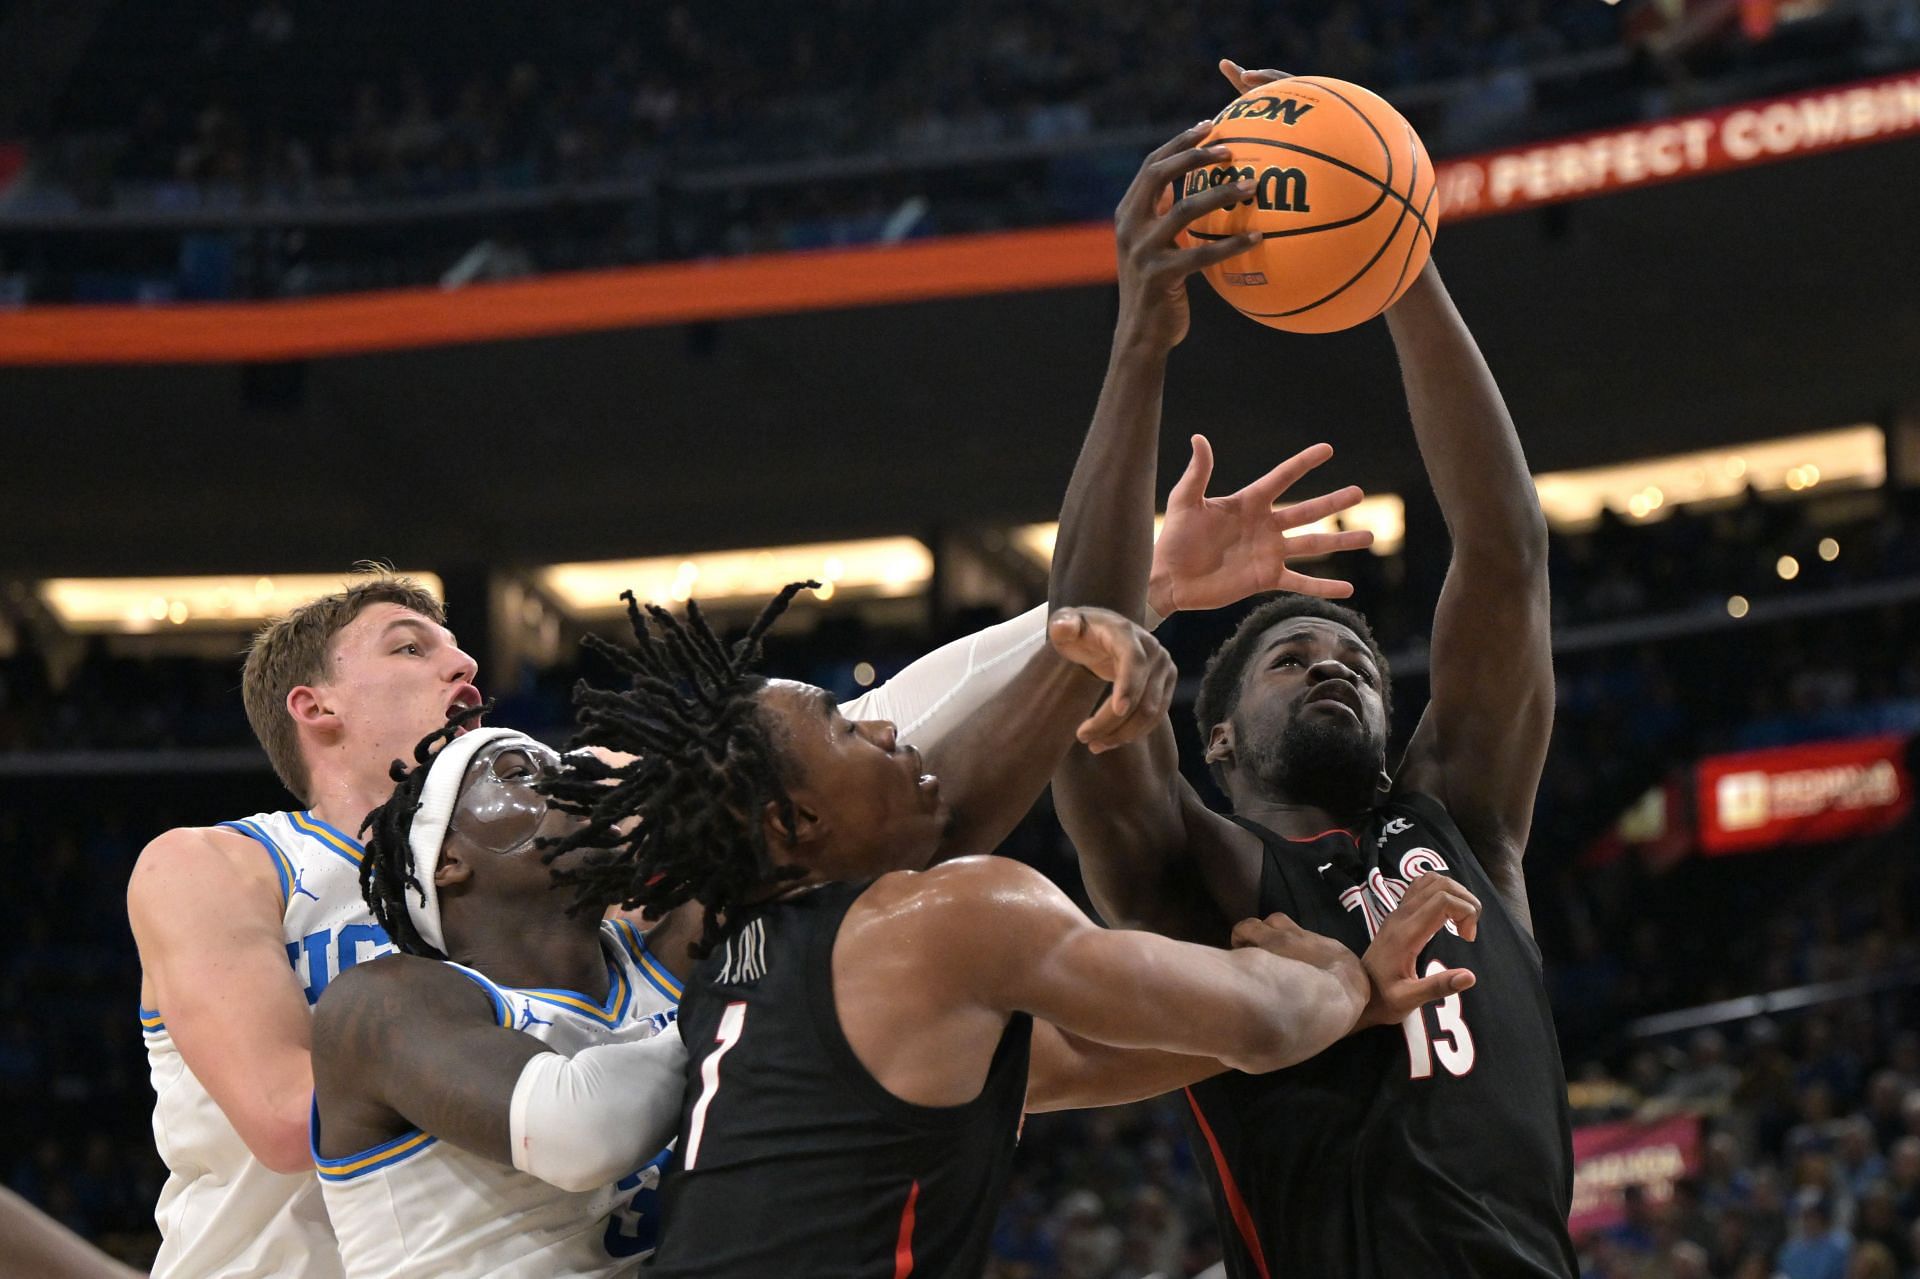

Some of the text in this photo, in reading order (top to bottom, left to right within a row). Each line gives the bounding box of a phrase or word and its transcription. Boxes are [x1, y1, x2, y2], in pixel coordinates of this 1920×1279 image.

[1490, 118, 1716, 208] PERFECT
[1401, 958, 1476, 1080] 13
[683, 1001, 748, 1171] 1
